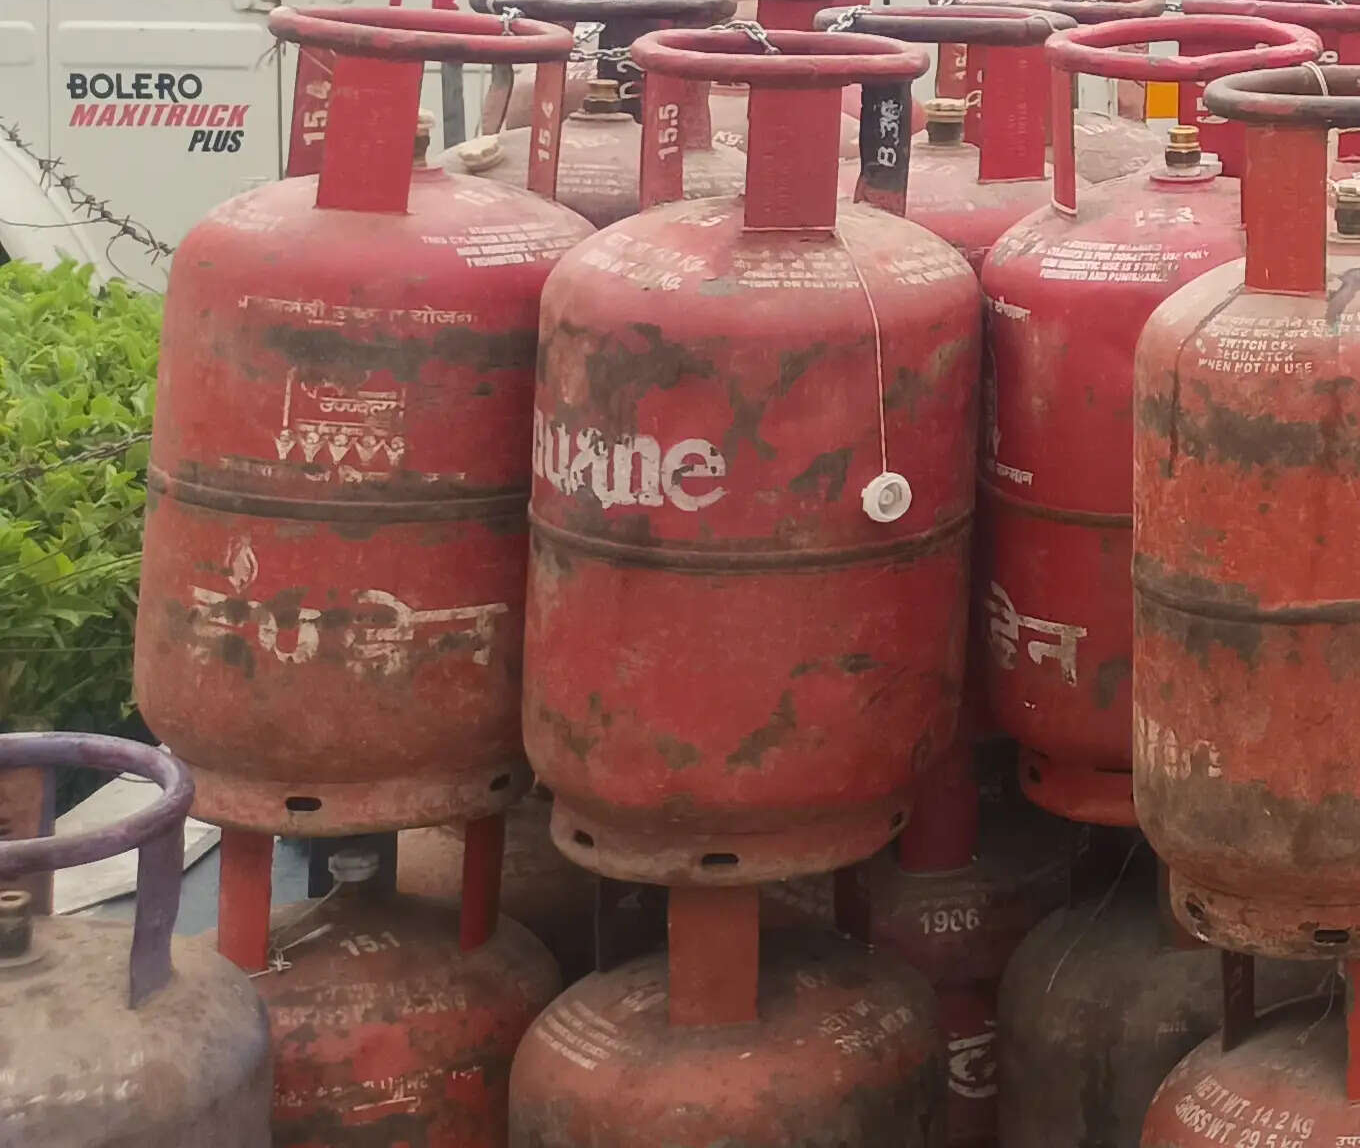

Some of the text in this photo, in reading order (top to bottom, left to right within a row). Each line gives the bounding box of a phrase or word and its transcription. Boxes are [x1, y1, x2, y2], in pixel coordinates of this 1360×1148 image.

[66, 73, 202, 102] BOLERO
[68, 104, 251, 127] MAXITRUCK
[187, 130, 245, 154] PLUS
[658, 103, 680, 161] 15.5
[1217, 338, 1267, 350] SWITCH
[919, 908, 981, 936] 1906
[1251, 1106, 1290, 1130] 14.2
